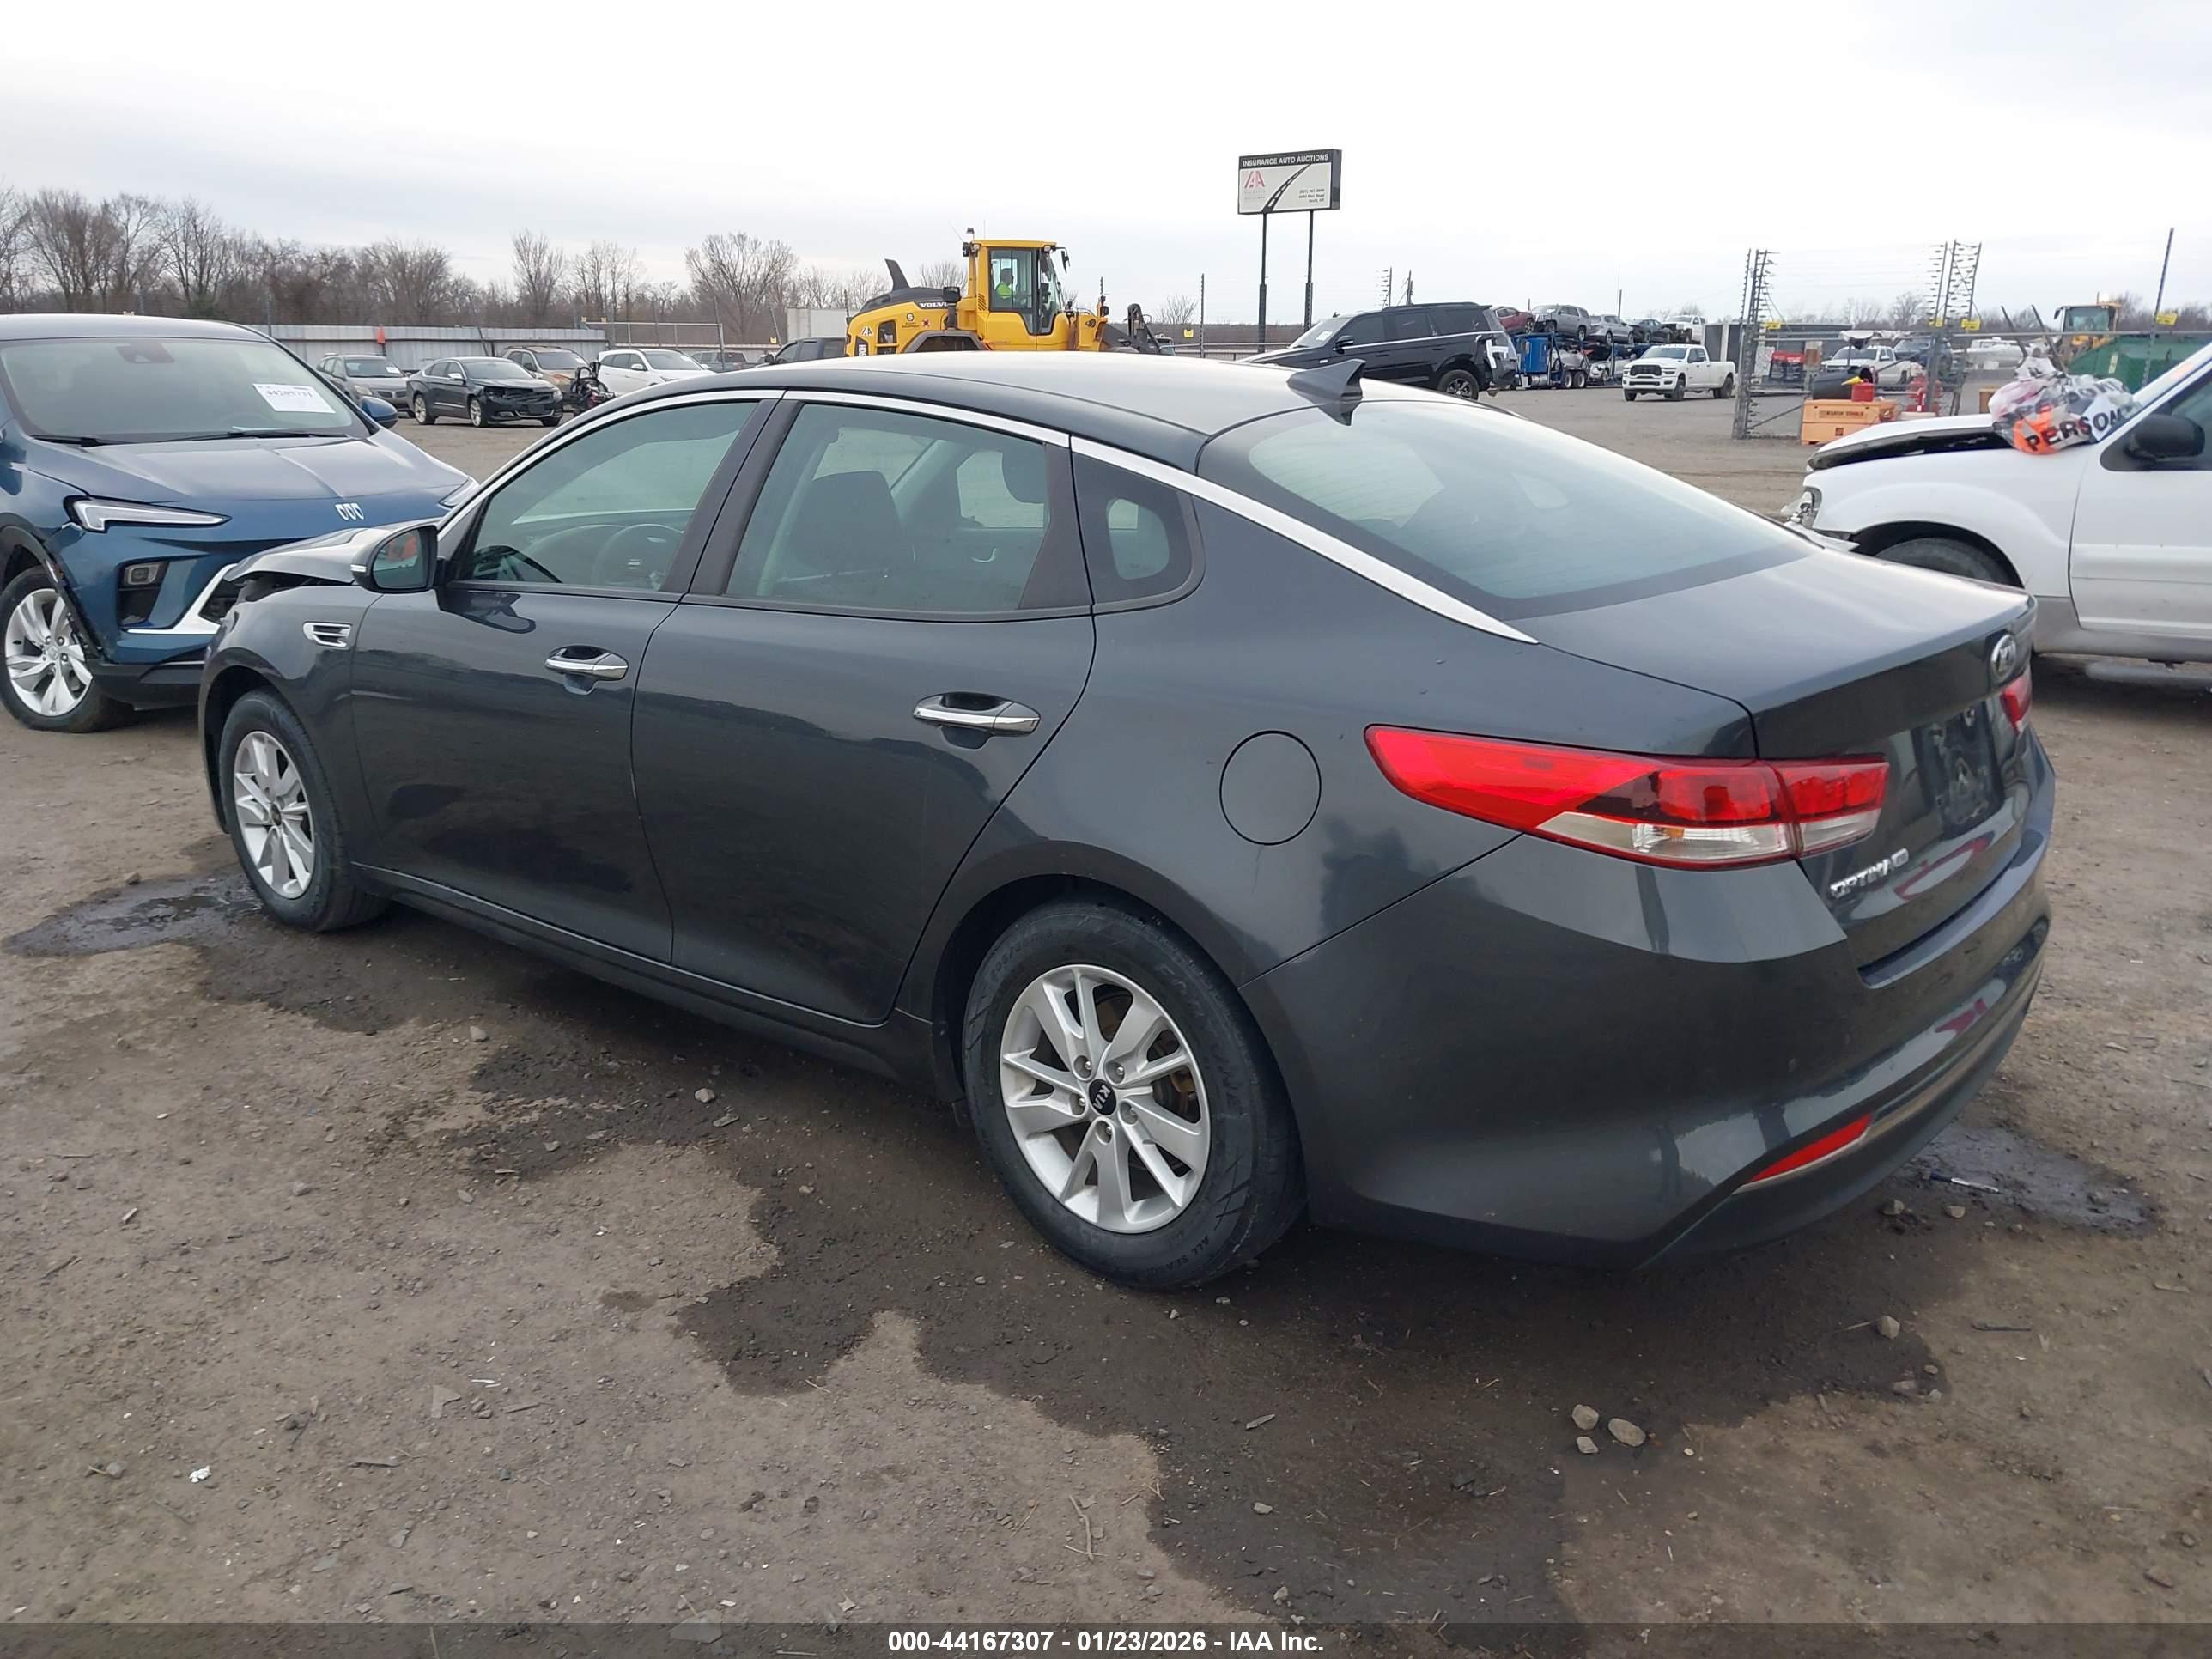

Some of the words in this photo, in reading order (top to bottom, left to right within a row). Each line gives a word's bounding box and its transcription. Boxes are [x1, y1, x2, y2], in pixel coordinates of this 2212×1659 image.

[1243, 157, 1278, 167] INSURANCE
[1297, 154, 1329, 163] AUCTIONS
[1092, 1084, 1111, 1110] KIA
